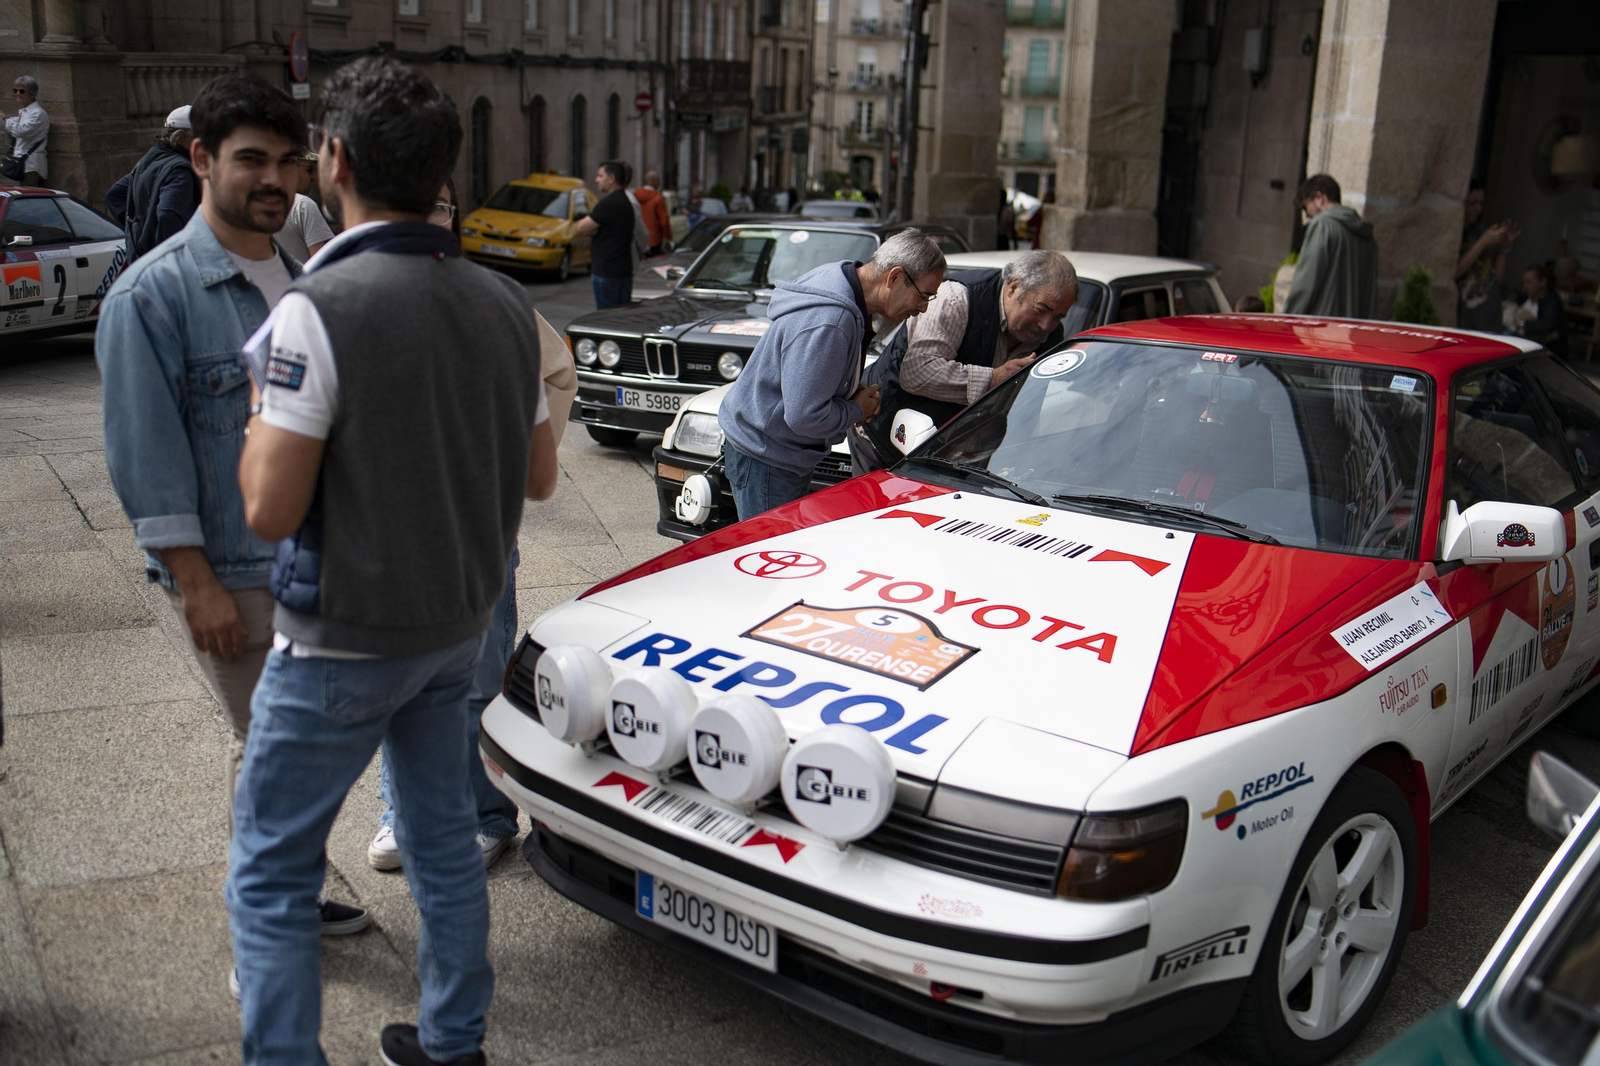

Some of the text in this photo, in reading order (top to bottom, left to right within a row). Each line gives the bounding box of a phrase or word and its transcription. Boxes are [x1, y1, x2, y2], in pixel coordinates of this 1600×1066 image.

[9, 280, 40, 300] Marlboro
[51, 264, 66, 316] 2
[687, 363, 711, 371] 320
[1201, 352, 1238, 363] RRT
[624, 391, 681, 411] GR 5988
[756, 613, 858, 644] 27
[845, 569, 1119, 665] TOYOTA
[871, 614, 899, 627] 5
[1341, 629, 1366, 647] JUAN
[1361, 611, 1394, 634] RECIMIL
[853, 626, 898, 643] RALLYE
[1360, 633, 1404, 664] ALEJANDRO
[1400, 619, 1427, 641] BARRIO
[806, 637, 938, 683] OURENSE
[543, 689, 565, 708] CIBIE
[611, 633, 949, 755] REPSOL
[1379, 665, 1429, 714] FUJITSU TEN
[1396, 694, 1420, 717] CAR AUDIO
[622, 716, 659, 733] CIBIE
[705, 747, 746, 764] CIBIE
[810, 781, 867, 799] CIBIE
[1241, 761, 1306, 801] REPSOL
[1250, 806, 1294, 835] Motor Oil
[659, 884, 769, 957] 3003 DSD
[1149, 924, 1251, 984] PIRELLI
